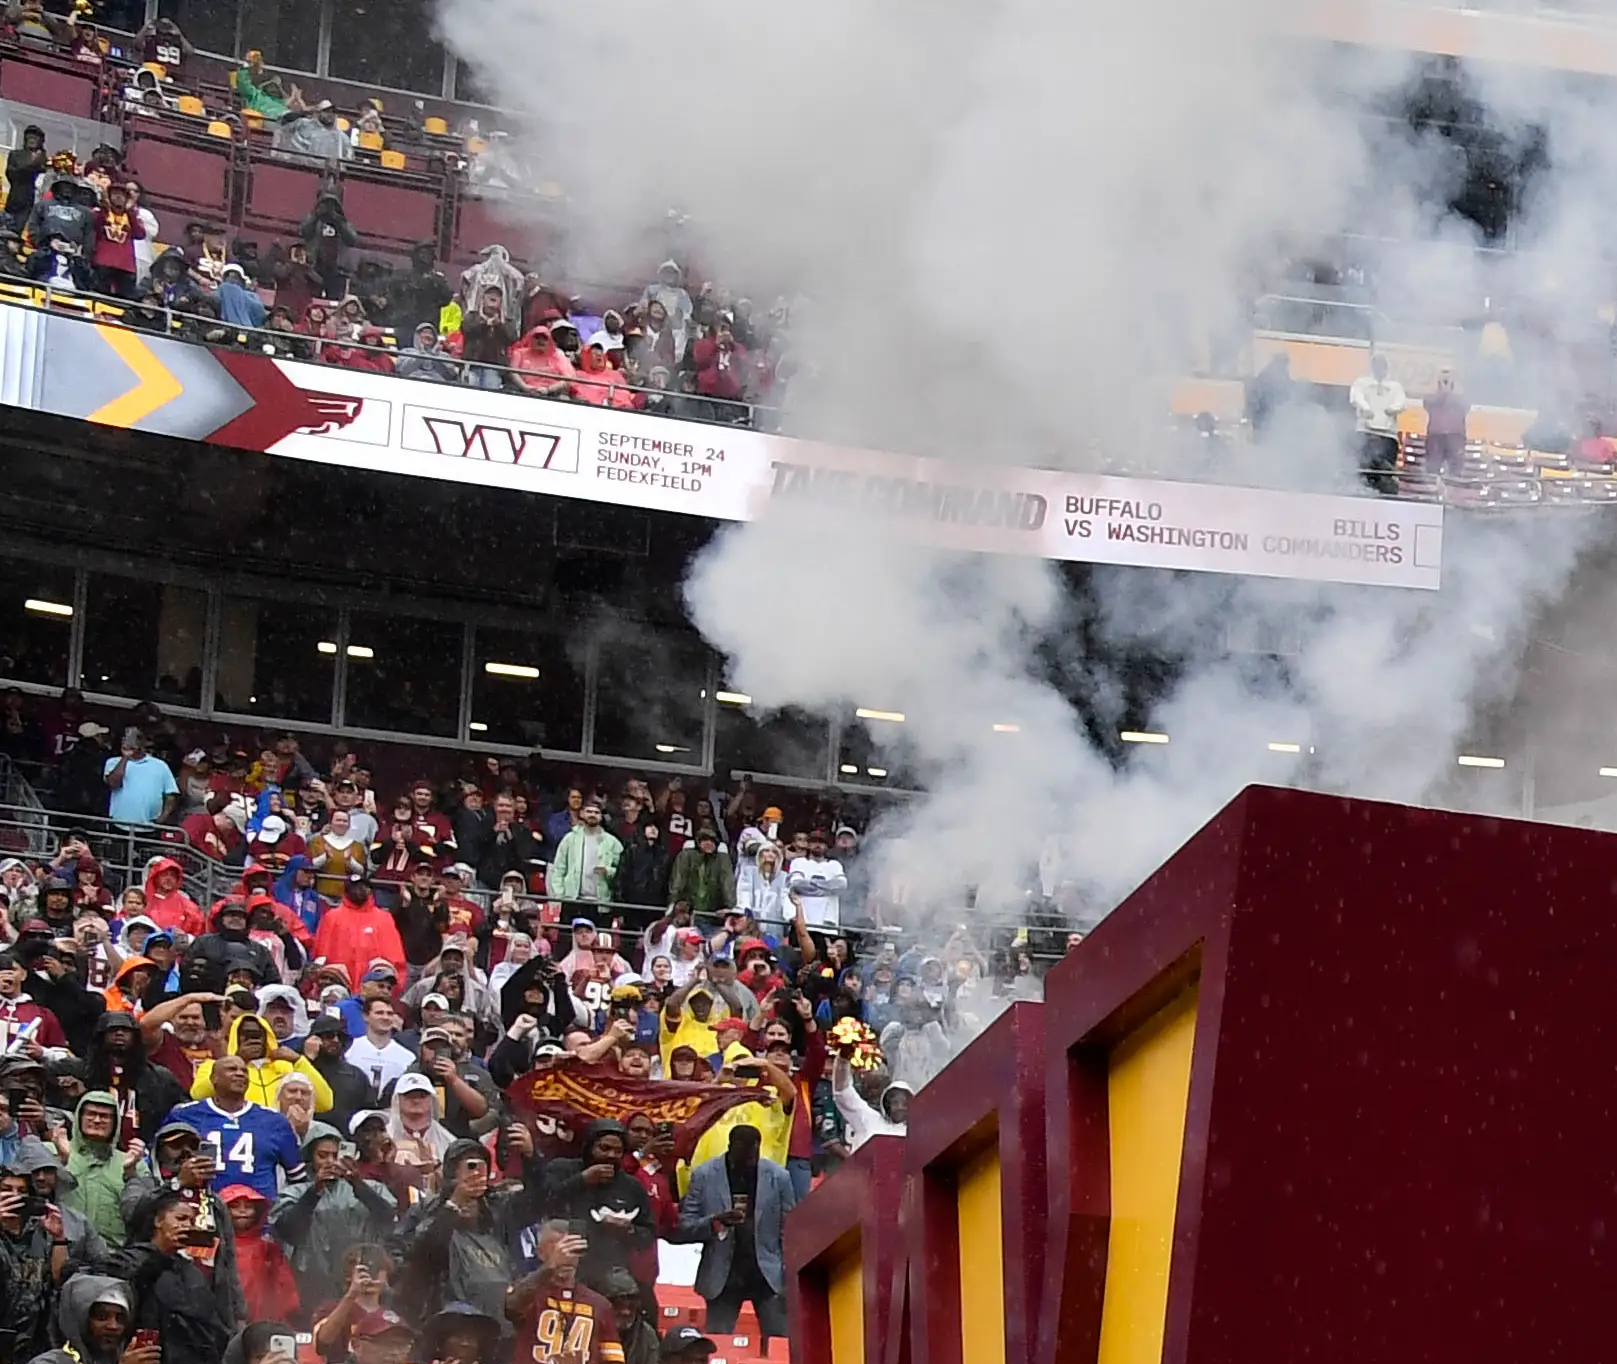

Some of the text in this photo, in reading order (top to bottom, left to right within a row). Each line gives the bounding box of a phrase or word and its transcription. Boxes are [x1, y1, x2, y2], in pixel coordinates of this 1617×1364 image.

[156, 44, 181, 65] 99
[598, 432, 726, 463] SEPTEMBER 24
[596, 466, 703, 493] FEDEXFIELD
[680, 461, 713, 478] 1PM
[1064, 495, 1163, 521] BUFFALO
[1064, 518, 1403, 564] VS WASHINGTON COMMANDERS
[1332, 518, 1401, 541] BILLS
[53, 733, 81, 755] 17
[668, 814, 694, 838] 21
[205, 1130, 255, 1174] 14
